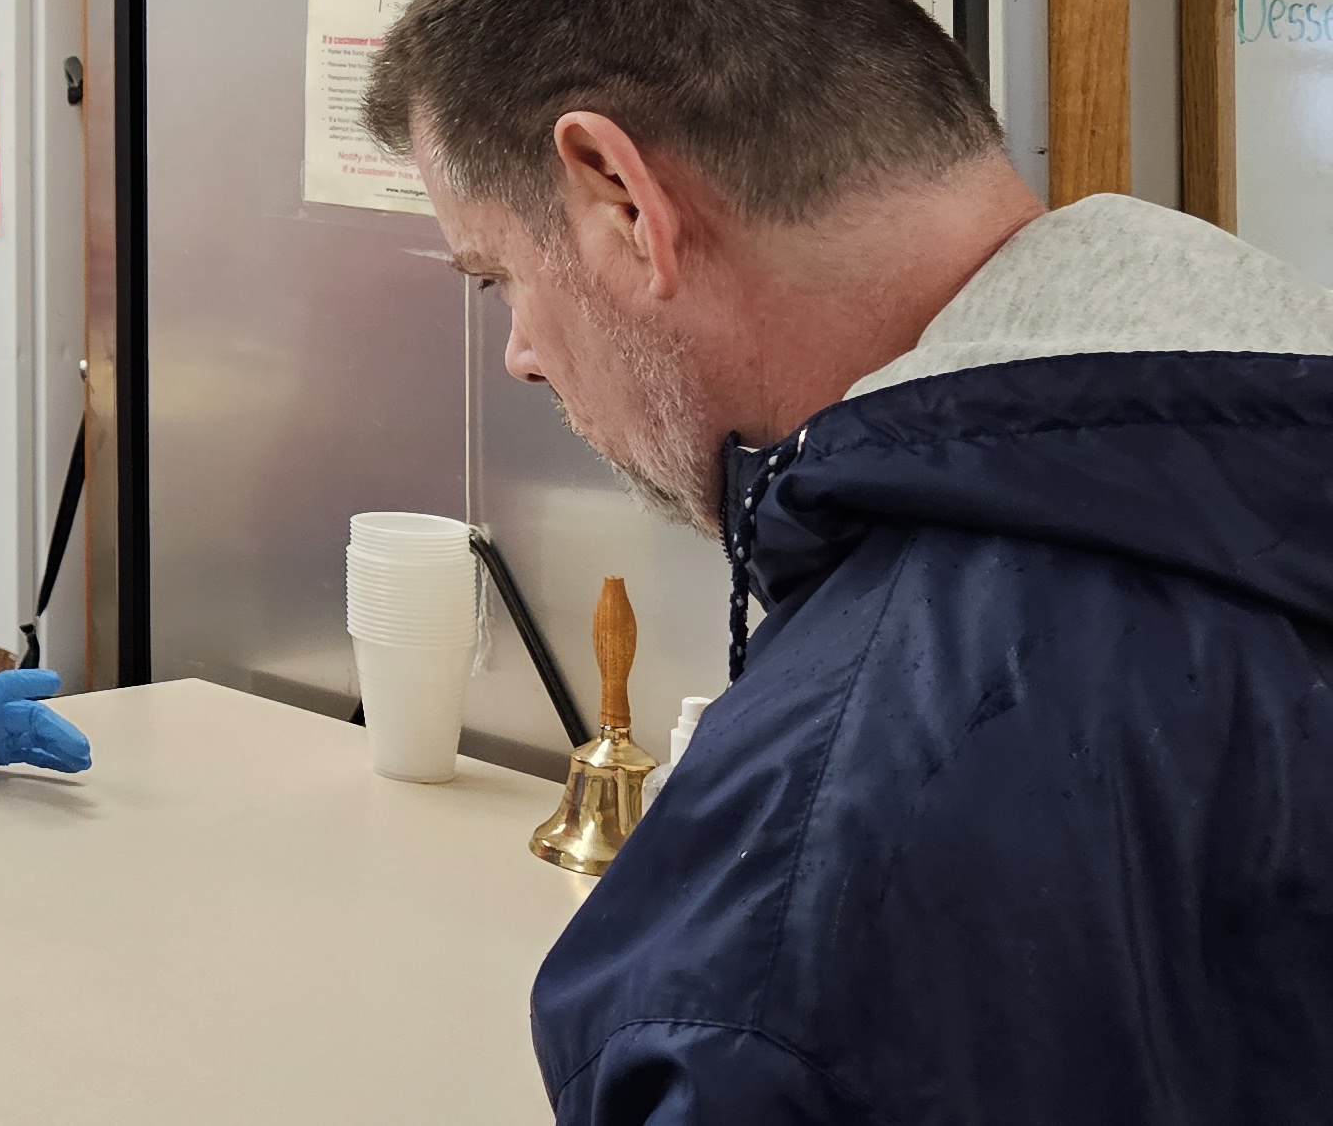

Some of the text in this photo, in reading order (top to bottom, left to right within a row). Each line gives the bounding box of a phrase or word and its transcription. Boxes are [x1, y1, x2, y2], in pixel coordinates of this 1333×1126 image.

[333, 37, 369, 46] customer
[338, 151, 362, 163] Notify
[357, 167, 397, 177] customer
[398, 171, 414, 179] has
